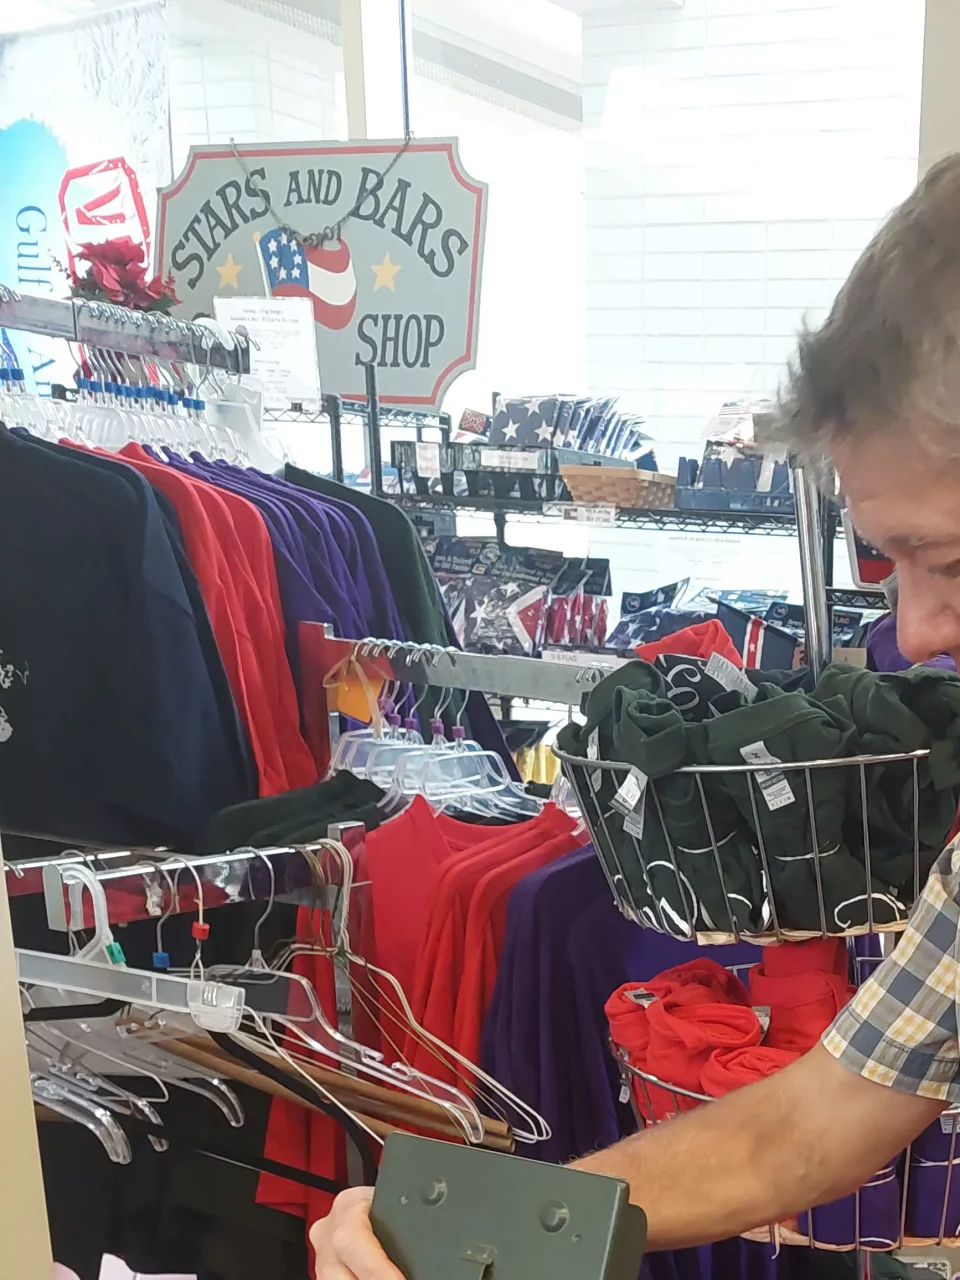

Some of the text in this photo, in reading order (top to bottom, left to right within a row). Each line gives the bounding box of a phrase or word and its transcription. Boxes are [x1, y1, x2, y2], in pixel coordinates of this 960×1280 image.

[15, 205, 54, 292] Gulf
[171, 167, 271, 290] STARS
[283, 169, 343, 207] AND
[350, 167, 469, 278] BARS
[355, 313, 445, 369] SHOP
